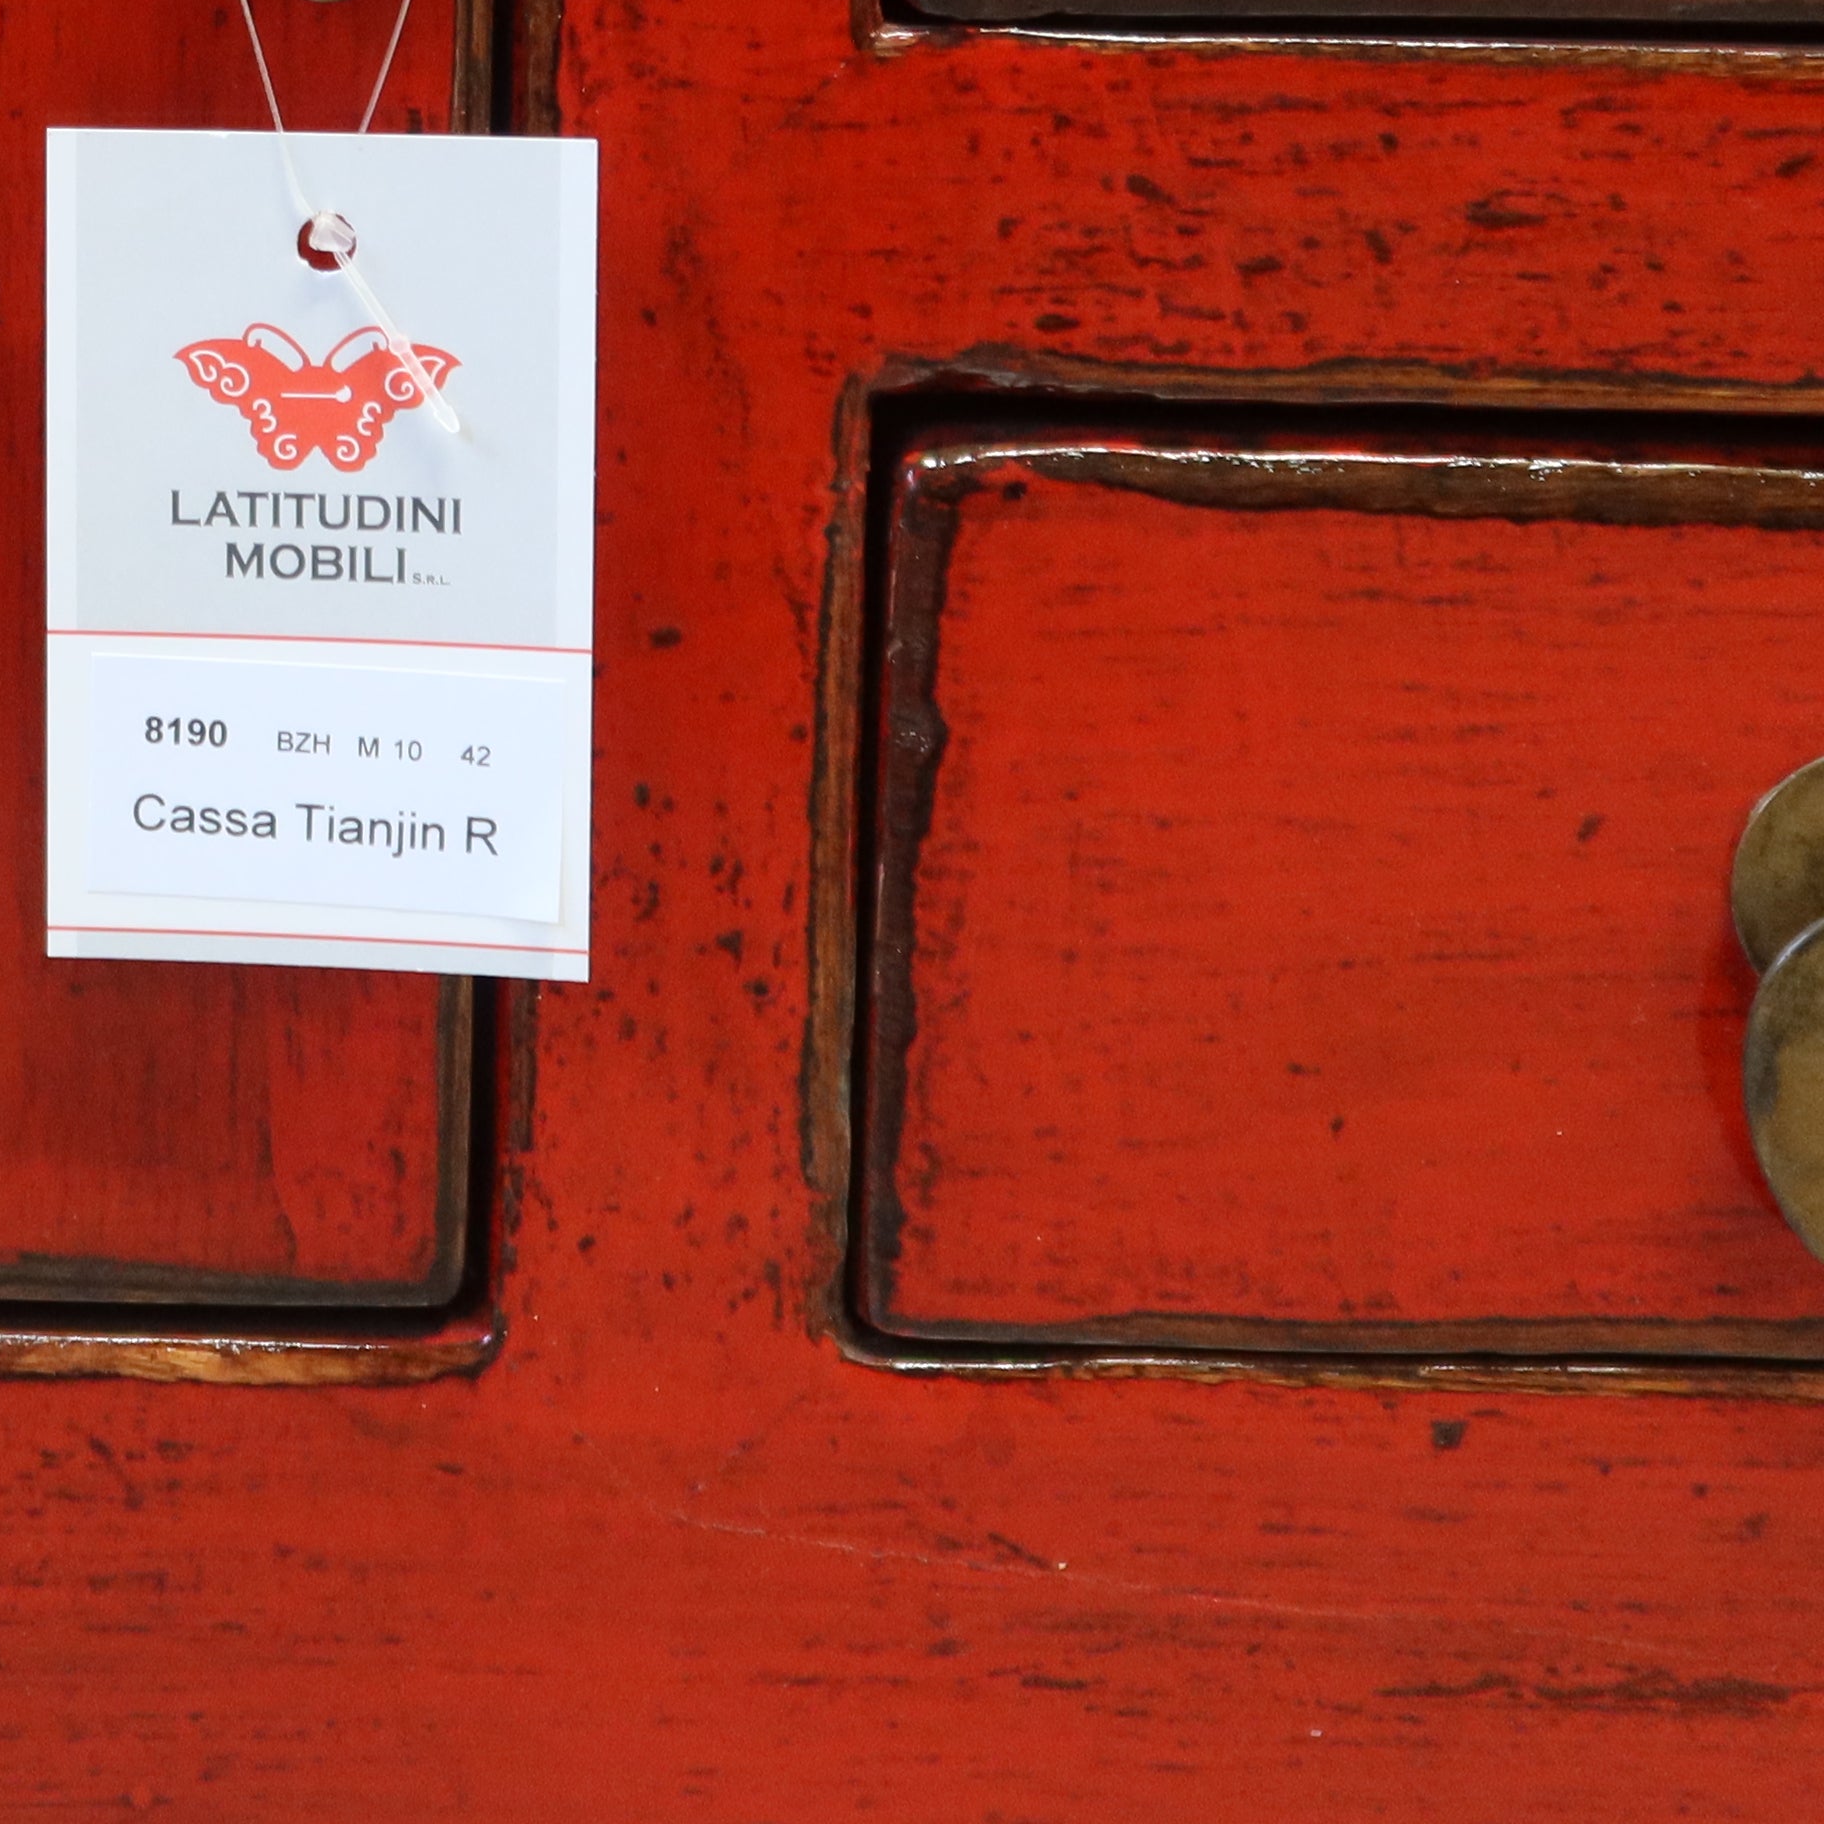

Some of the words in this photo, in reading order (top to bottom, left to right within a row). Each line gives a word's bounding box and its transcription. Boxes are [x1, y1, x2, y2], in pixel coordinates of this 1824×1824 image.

[171, 489, 462, 535] LATITUDINI
[225, 542, 406, 584] MOBILI
[144, 715, 228, 748] 8190
[277, 730, 331, 755] BZH
[358, 736, 380, 758] M
[394, 739, 423, 762] 10
[460, 745, 491, 767] 42
[133, 792, 277, 839] Cassa
[295, 803, 445, 859] Tianjin
[465, 815, 498, 856] R
